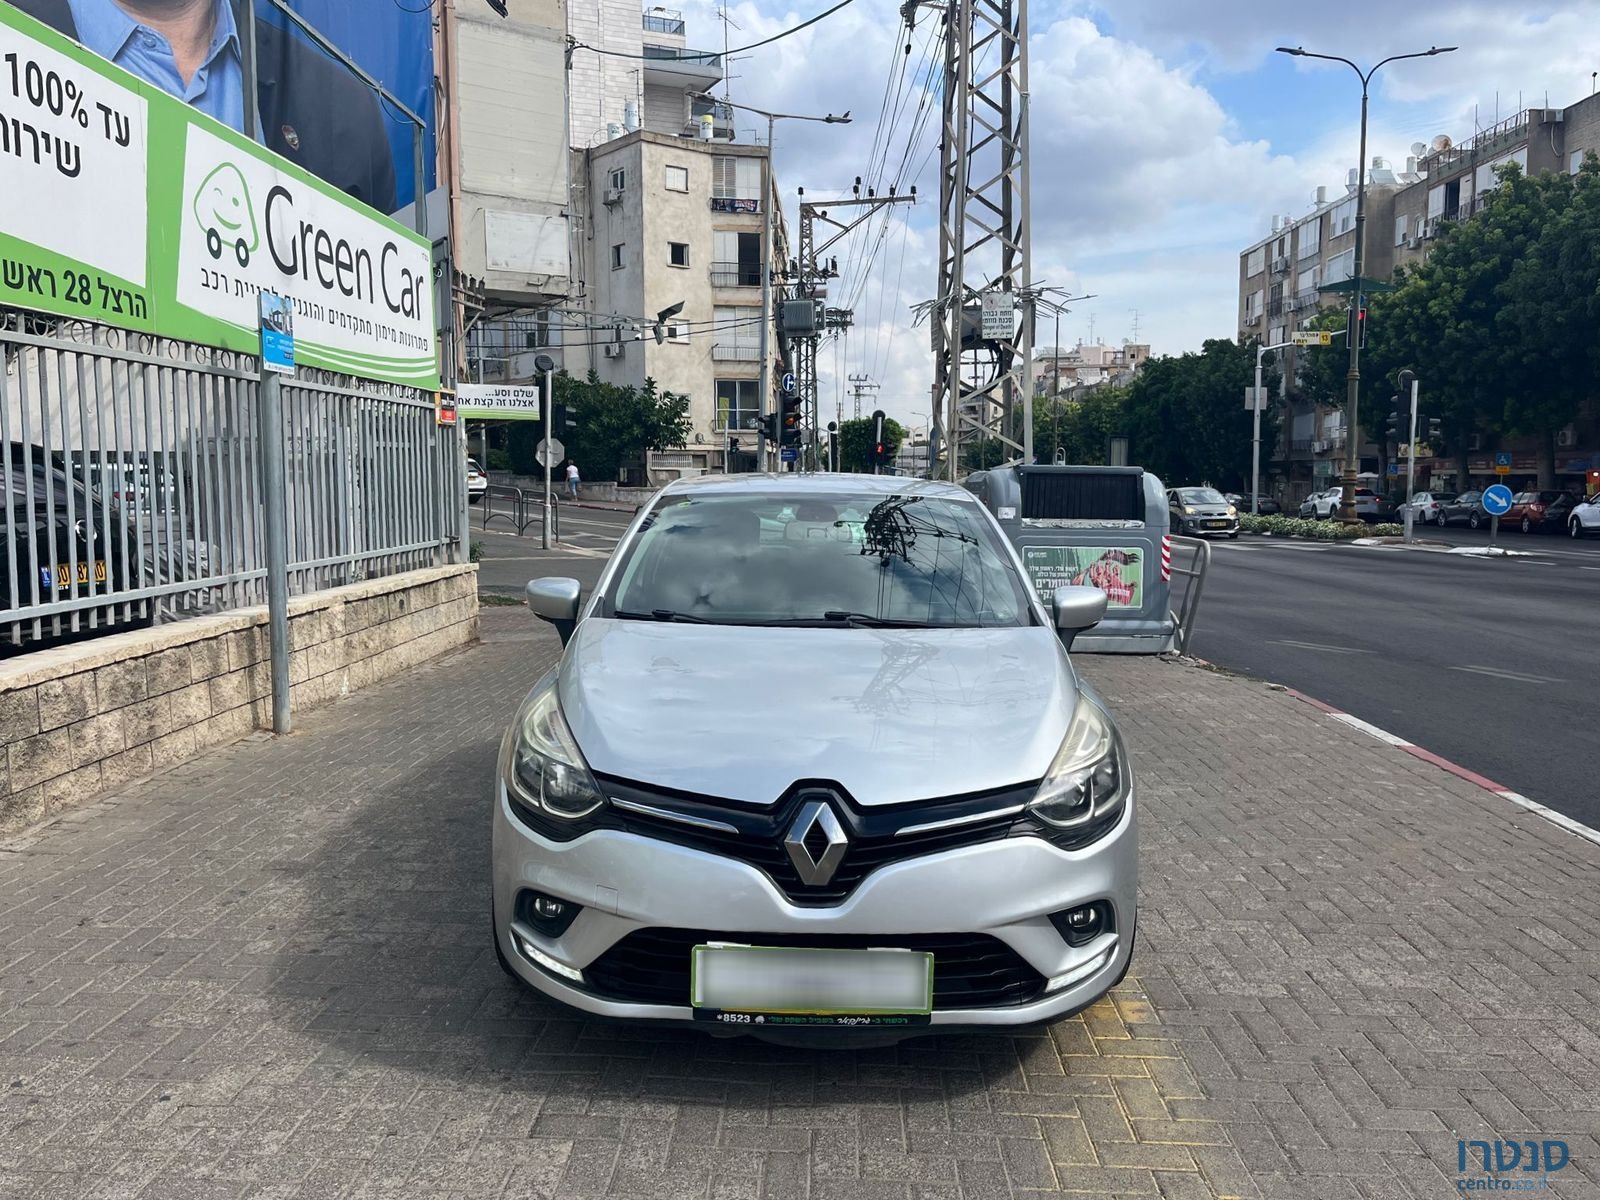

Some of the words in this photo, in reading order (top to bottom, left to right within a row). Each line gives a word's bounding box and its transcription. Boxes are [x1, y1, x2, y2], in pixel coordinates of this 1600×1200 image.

[5, 53, 88, 128] 100%
[96, 101, 130, 147] עד
[265, 185, 374, 304] Green
[381, 241, 424, 321] Car
[3, 258, 56, 298] ראש
[63, 270, 91, 305] 28
[201, 268, 228, 293] רכב
[97, 276, 147, 319] הרצל
[329, 308, 372, 335] מתקדמים
[375, 323, 397, 341] מימון
[400, 331, 428, 351] פתרונות
[473, 397, 493, 408] קצת
[485, 389, 510, 397] וסע...
[496, 399, 506, 407] זה
[509, 398, 534, 407] אצלנו
[513, 389, 534, 398] שלם
